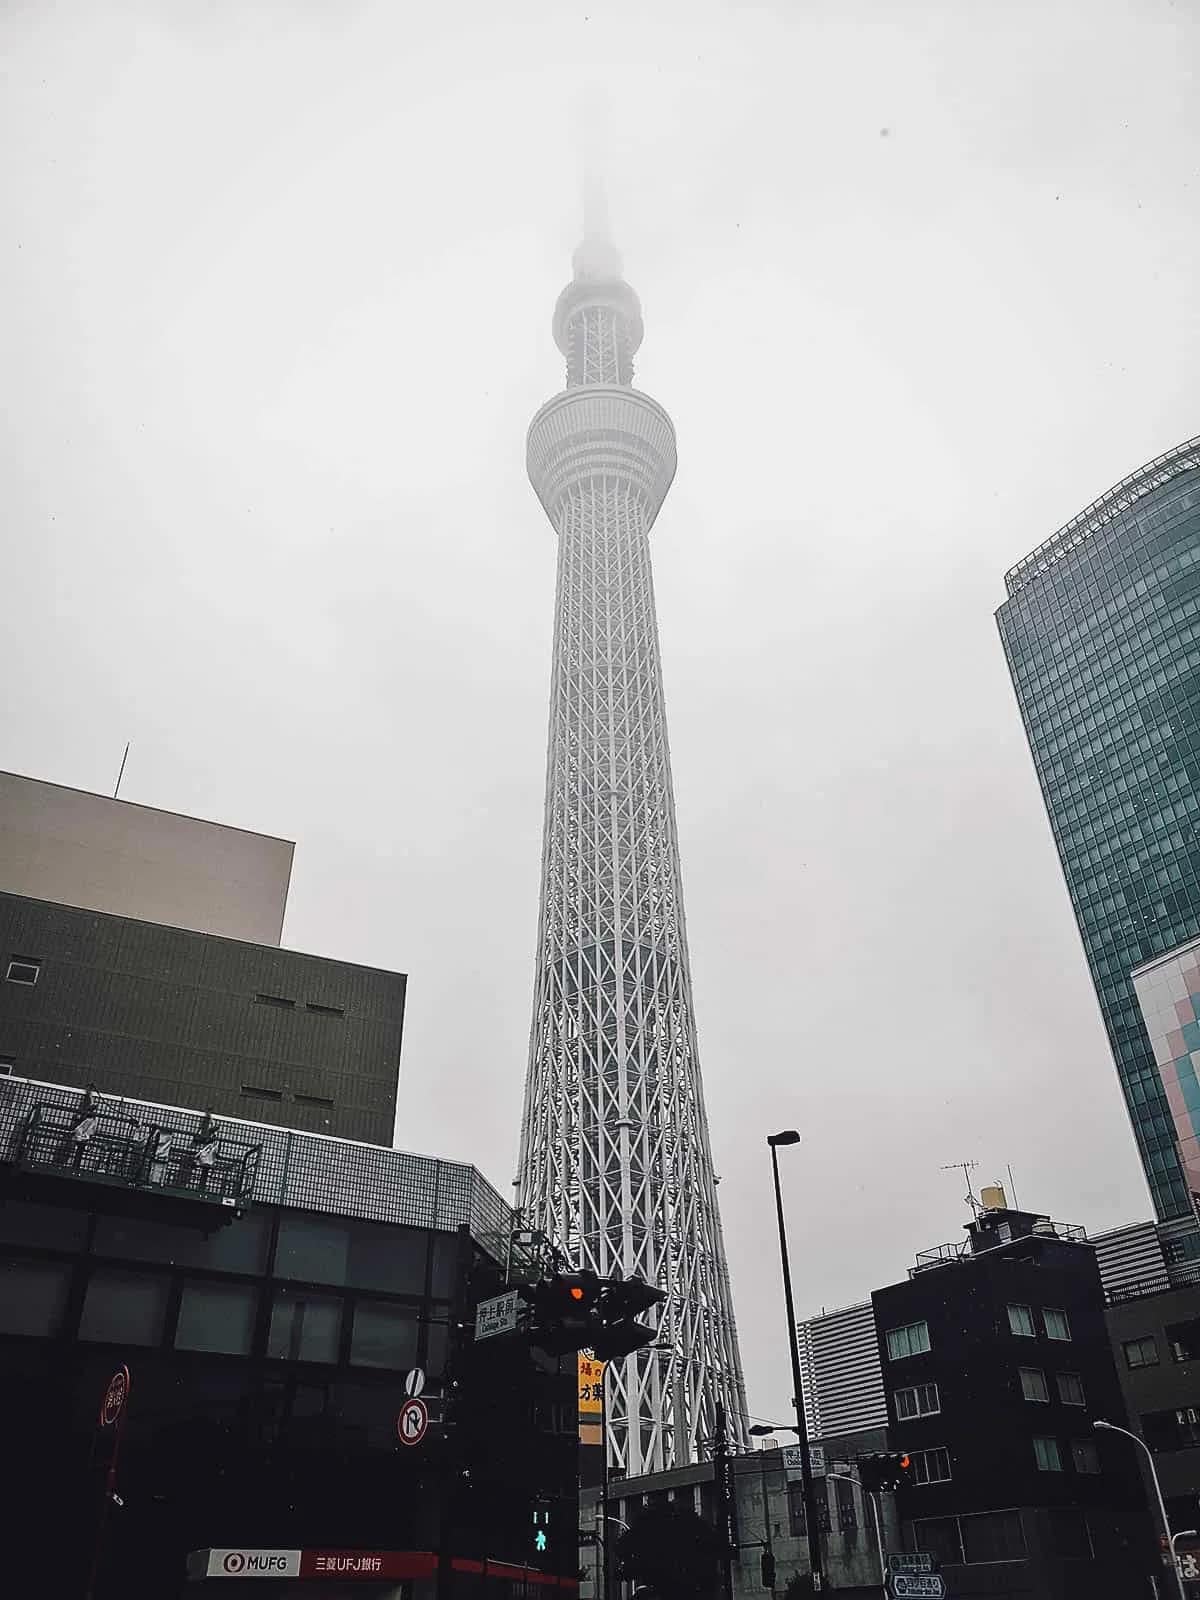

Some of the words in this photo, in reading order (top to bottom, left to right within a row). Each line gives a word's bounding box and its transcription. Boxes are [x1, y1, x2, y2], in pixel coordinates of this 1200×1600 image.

[247, 1556, 287, 1570] MUFG
[315, 1557, 382, 1571] 三菱UFJ銀行
